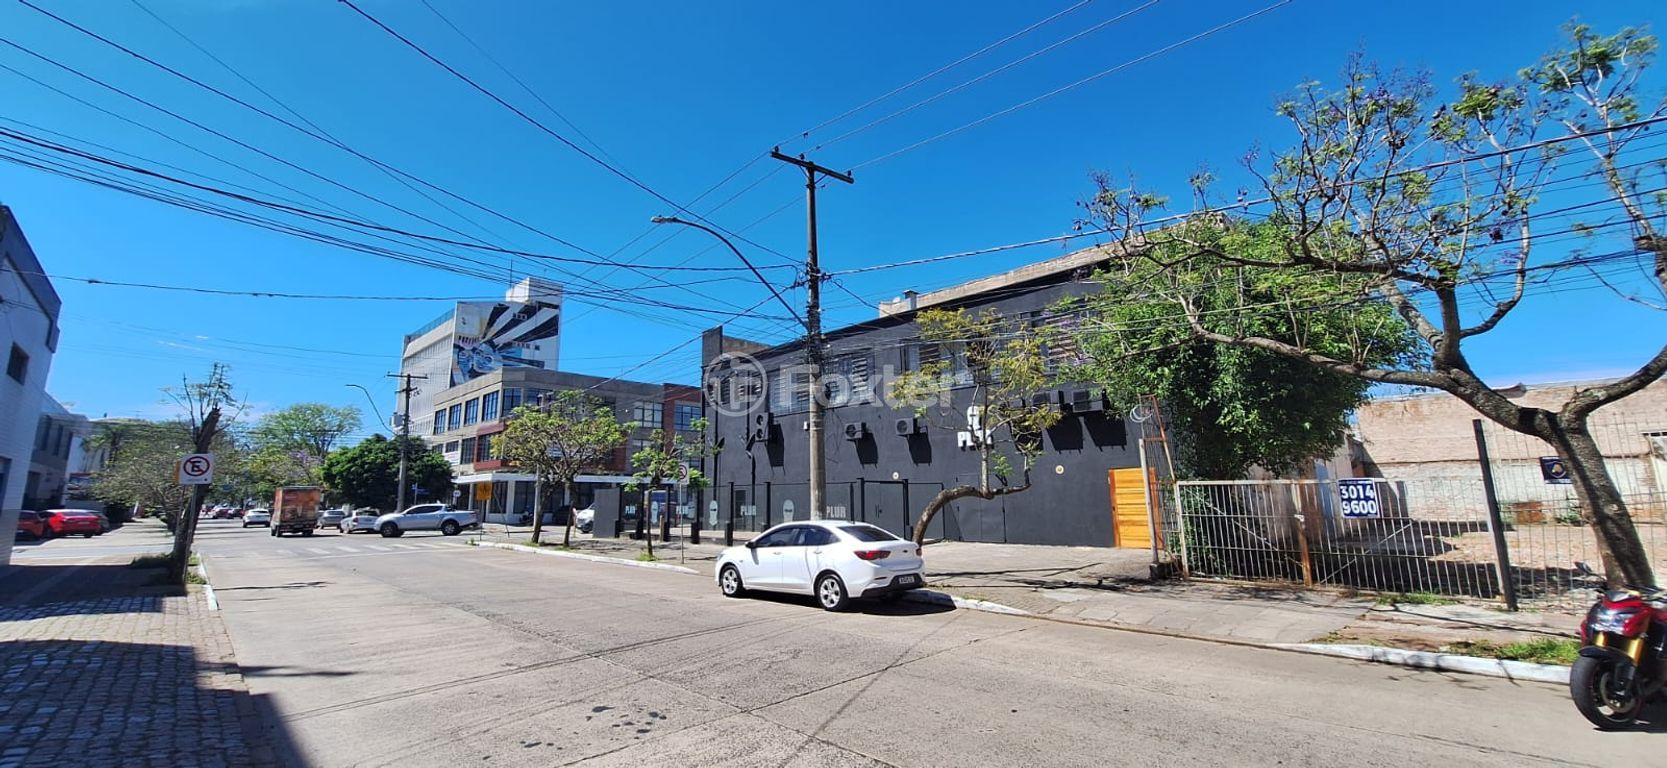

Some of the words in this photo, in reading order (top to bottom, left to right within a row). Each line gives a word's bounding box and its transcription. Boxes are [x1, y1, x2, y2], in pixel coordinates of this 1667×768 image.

[1340, 484, 1375, 499] 3014
[826, 505, 846, 518] PLUR
[1342, 500, 1377, 514] 9600
